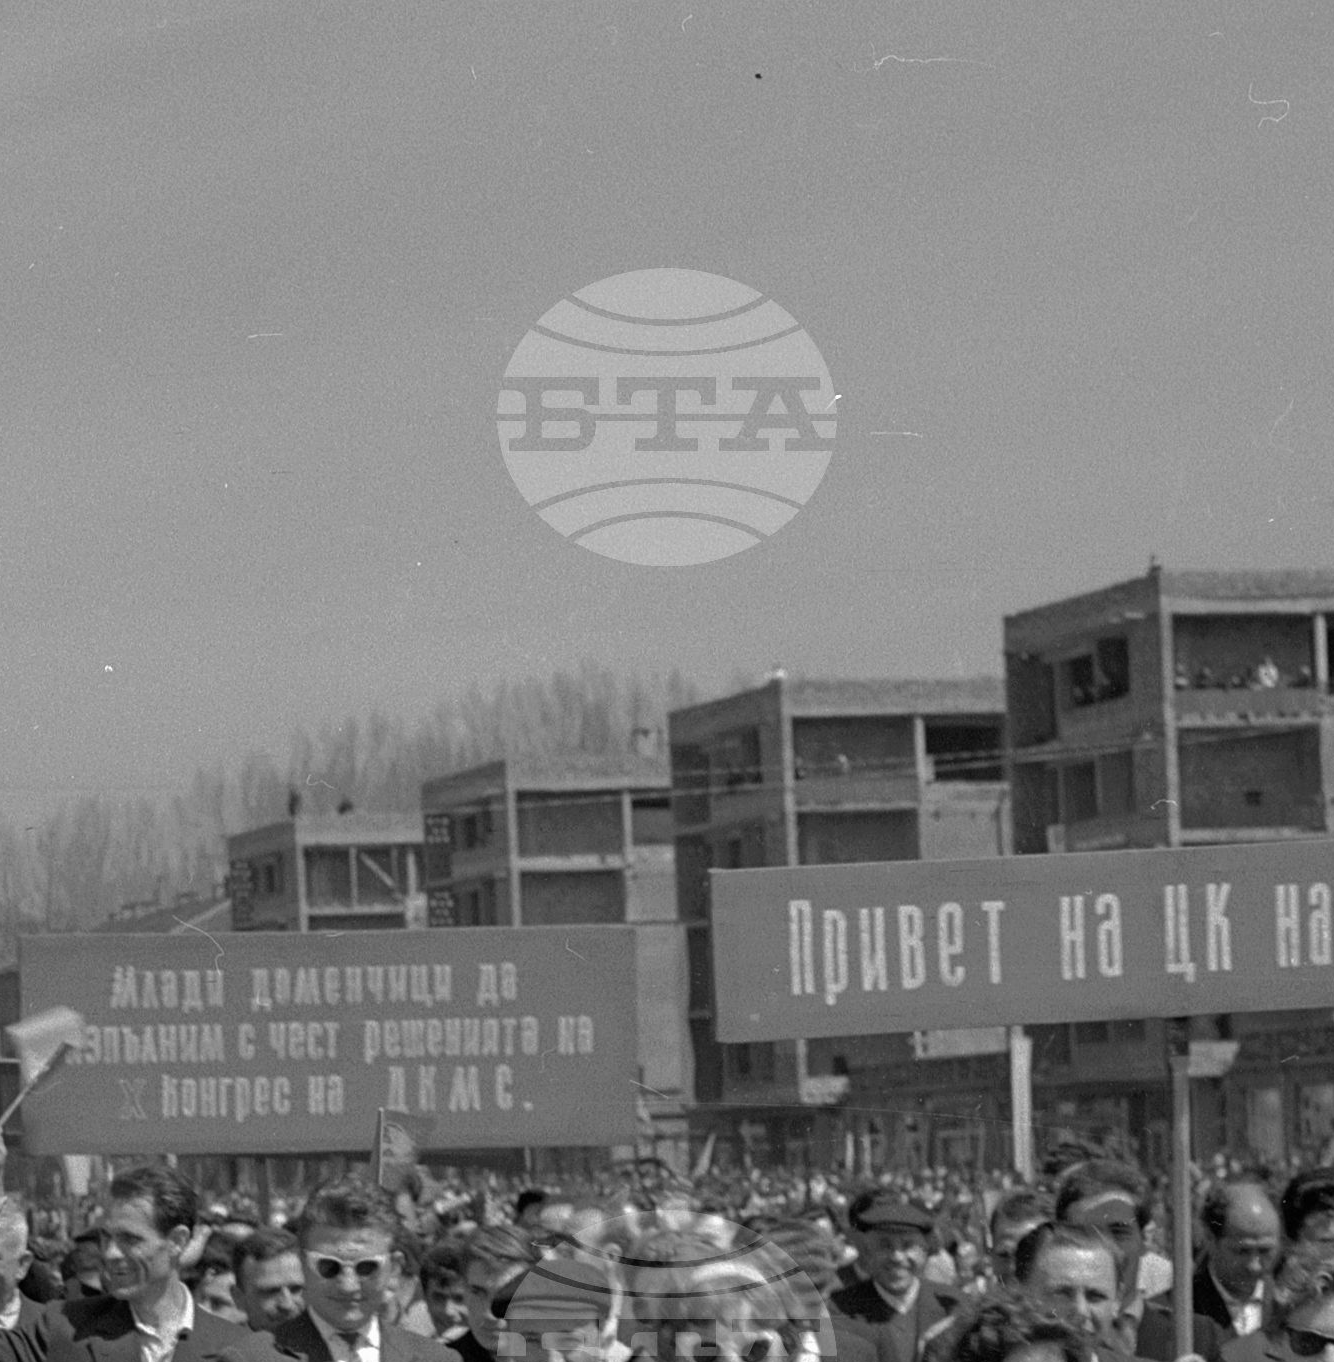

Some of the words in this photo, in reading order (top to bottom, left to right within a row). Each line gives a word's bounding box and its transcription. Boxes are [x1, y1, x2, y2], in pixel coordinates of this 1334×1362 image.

[788, 899, 1005, 1006] Привет
[1060, 892, 1124, 980] на
[1164, 882, 1233, 982] ЦК
[1274, 881, 1333, 968] на
[110, 965, 225, 1013] Млади
[477, 961, 518, 1008] да
[238, 1022, 257, 1060] с
[268, 1021, 341, 1060] чест
[363, 1015, 540, 1066] решенията
[557, 1014, 595, 1056] на
[307, 1074, 345, 1116] на
